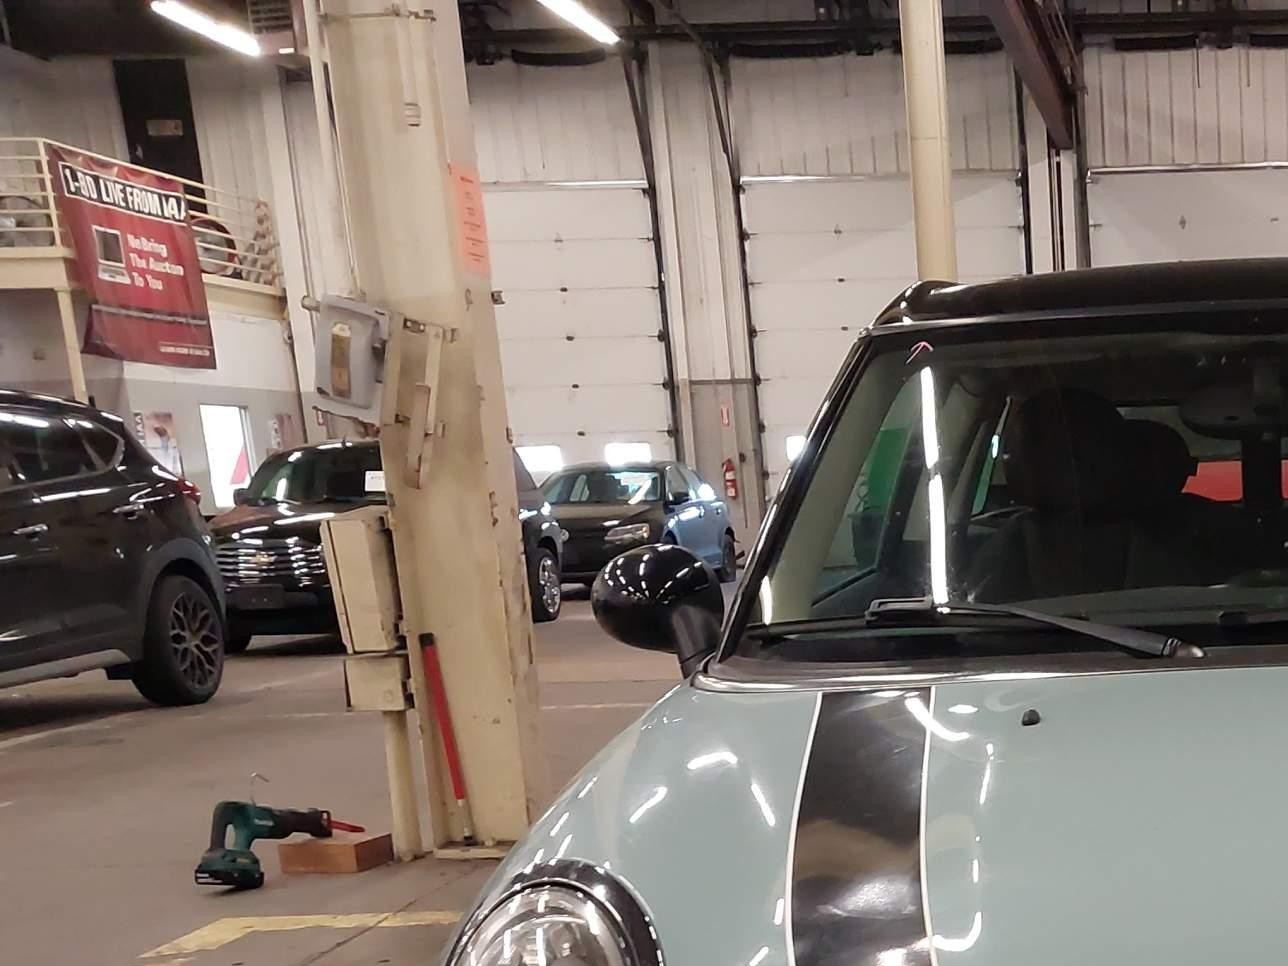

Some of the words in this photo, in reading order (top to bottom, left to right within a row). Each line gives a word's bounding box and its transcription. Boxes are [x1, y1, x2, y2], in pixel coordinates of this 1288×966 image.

[99, 178, 126, 207] LIVE
[126, 186, 162, 216] FROM
[132, 272, 144, 287] To
[145, 274, 163, 290] You
